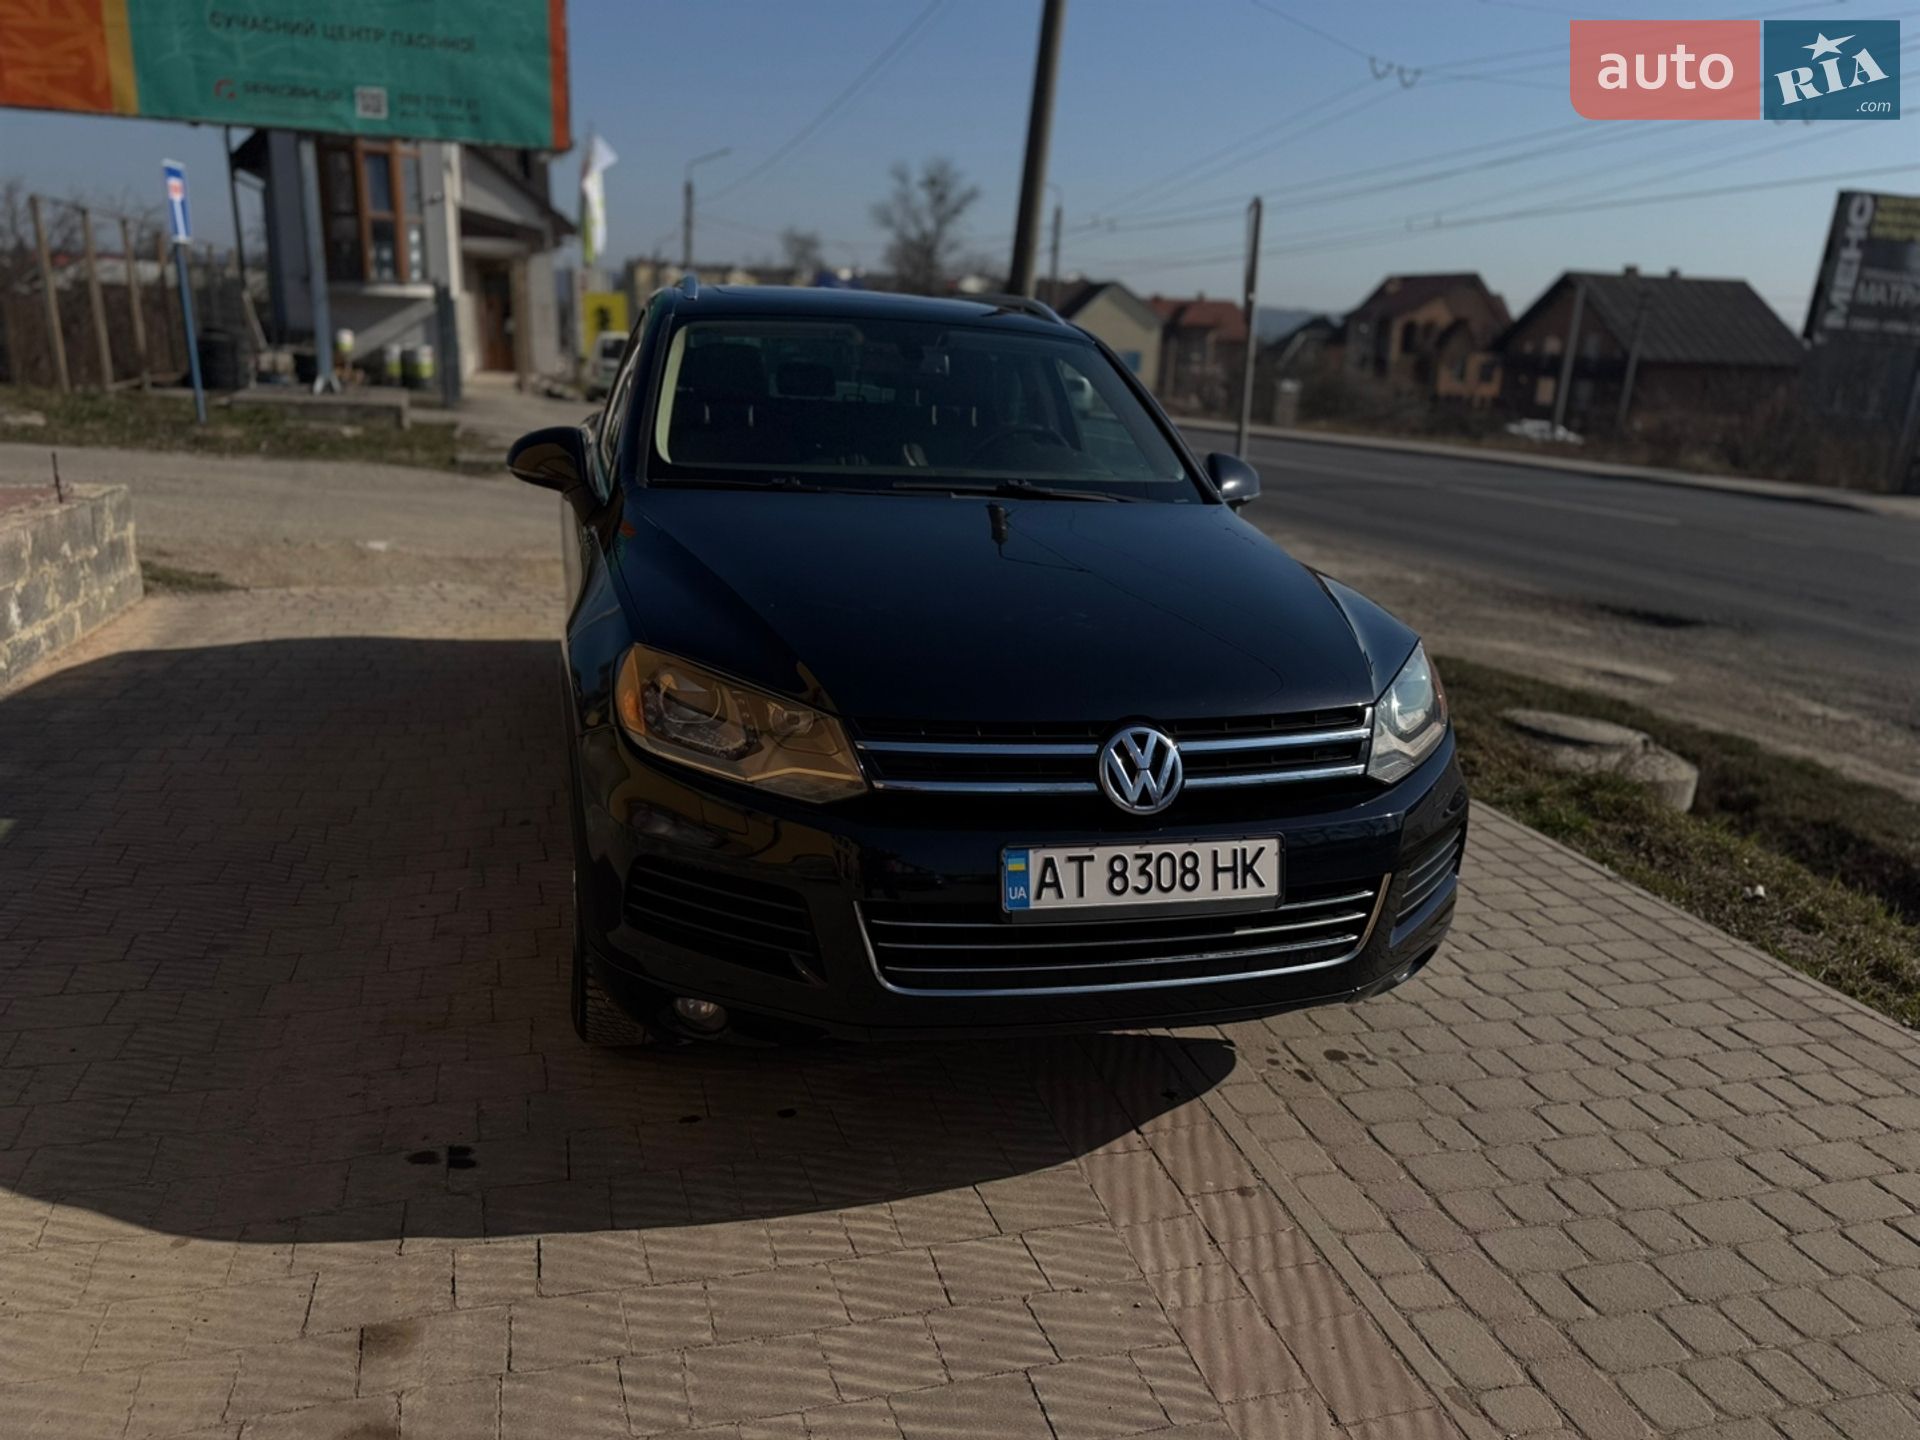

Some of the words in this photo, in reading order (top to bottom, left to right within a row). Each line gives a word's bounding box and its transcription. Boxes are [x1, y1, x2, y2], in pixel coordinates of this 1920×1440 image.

[209, 10, 316, 38] СУЧАСНИЙ
[322, 23, 385, 42] ЦЕНТР
[1035, 855, 1095, 900] AT
[1108, 851, 1200, 896] 8308
[1211, 846, 1266, 891] HK
[1008, 887, 1027, 900] UA
